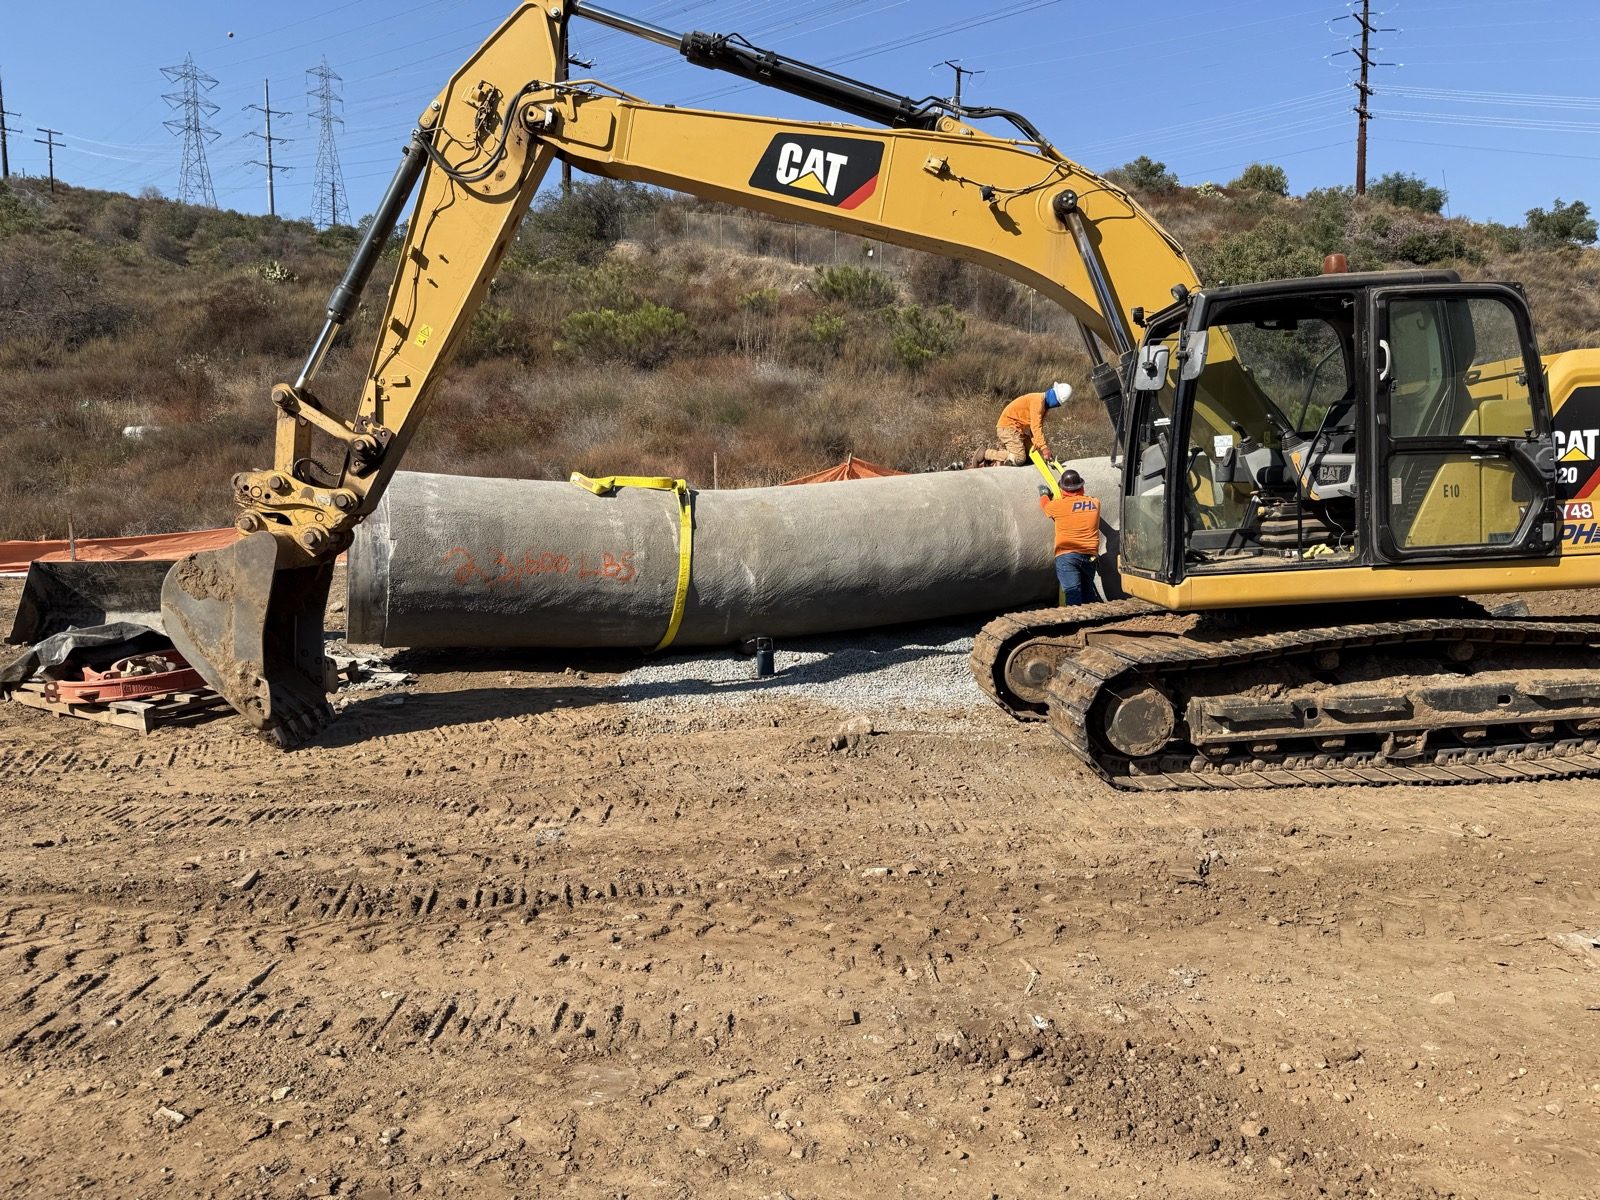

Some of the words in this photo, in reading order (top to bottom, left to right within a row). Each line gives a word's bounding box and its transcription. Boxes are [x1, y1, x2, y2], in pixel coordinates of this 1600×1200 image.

[776, 142, 848, 196] CAT
[1552, 429, 1600, 461] CAT
[1320, 465, 1342, 481] CAT
[1443, 484, 1460, 498] E10
[578, 551, 636, 583] LBS
